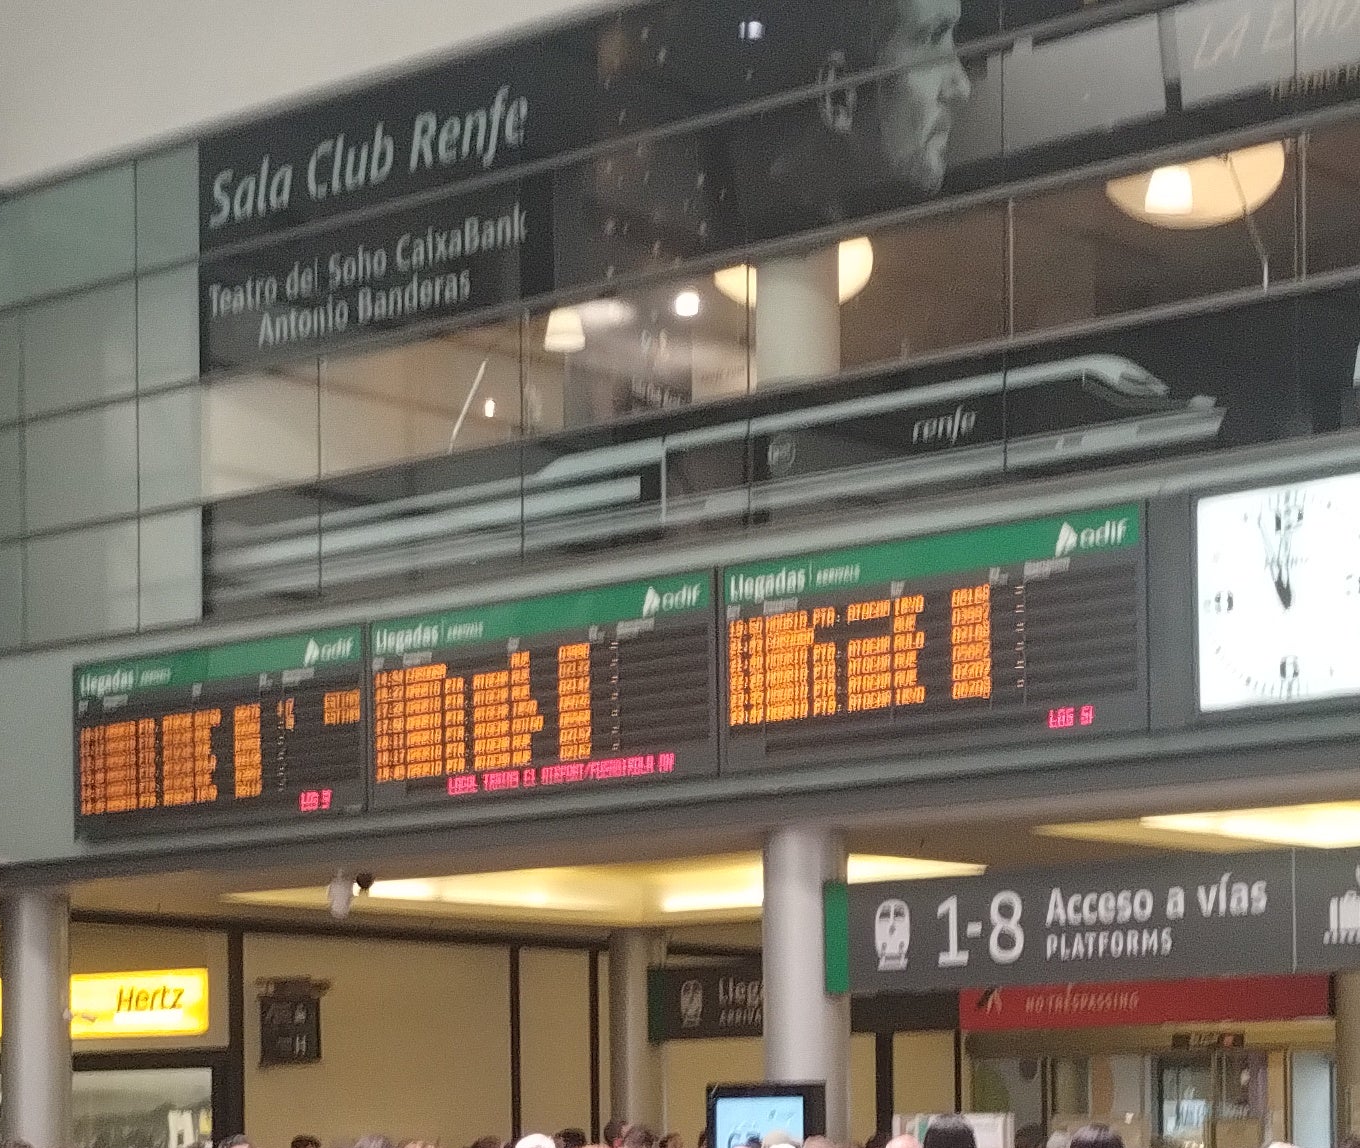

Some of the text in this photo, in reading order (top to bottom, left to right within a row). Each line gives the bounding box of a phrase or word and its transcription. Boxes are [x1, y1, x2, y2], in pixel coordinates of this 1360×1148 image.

[209, 86, 529, 228] Sala Club Renfe
[209, 203, 527, 317] Teatro del Soho CaixaBank
[258, 269, 471, 348] Antonio Banderas
[912, 405, 977, 445] renfe
[1080, 518, 1129, 550] adif
[662, 583, 702, 612] adif
[729, 566, 806, 603] Llegadas
[374, 622, 440, 655] Llegadas
[937, 872, 1268, 968] 1-8 Acceso a vías
[1046, 927, 1173, 961] PLATFORMS
[116, 985, 185, 1013] Hertz
[719, 976, 763, 1007] Lleg
